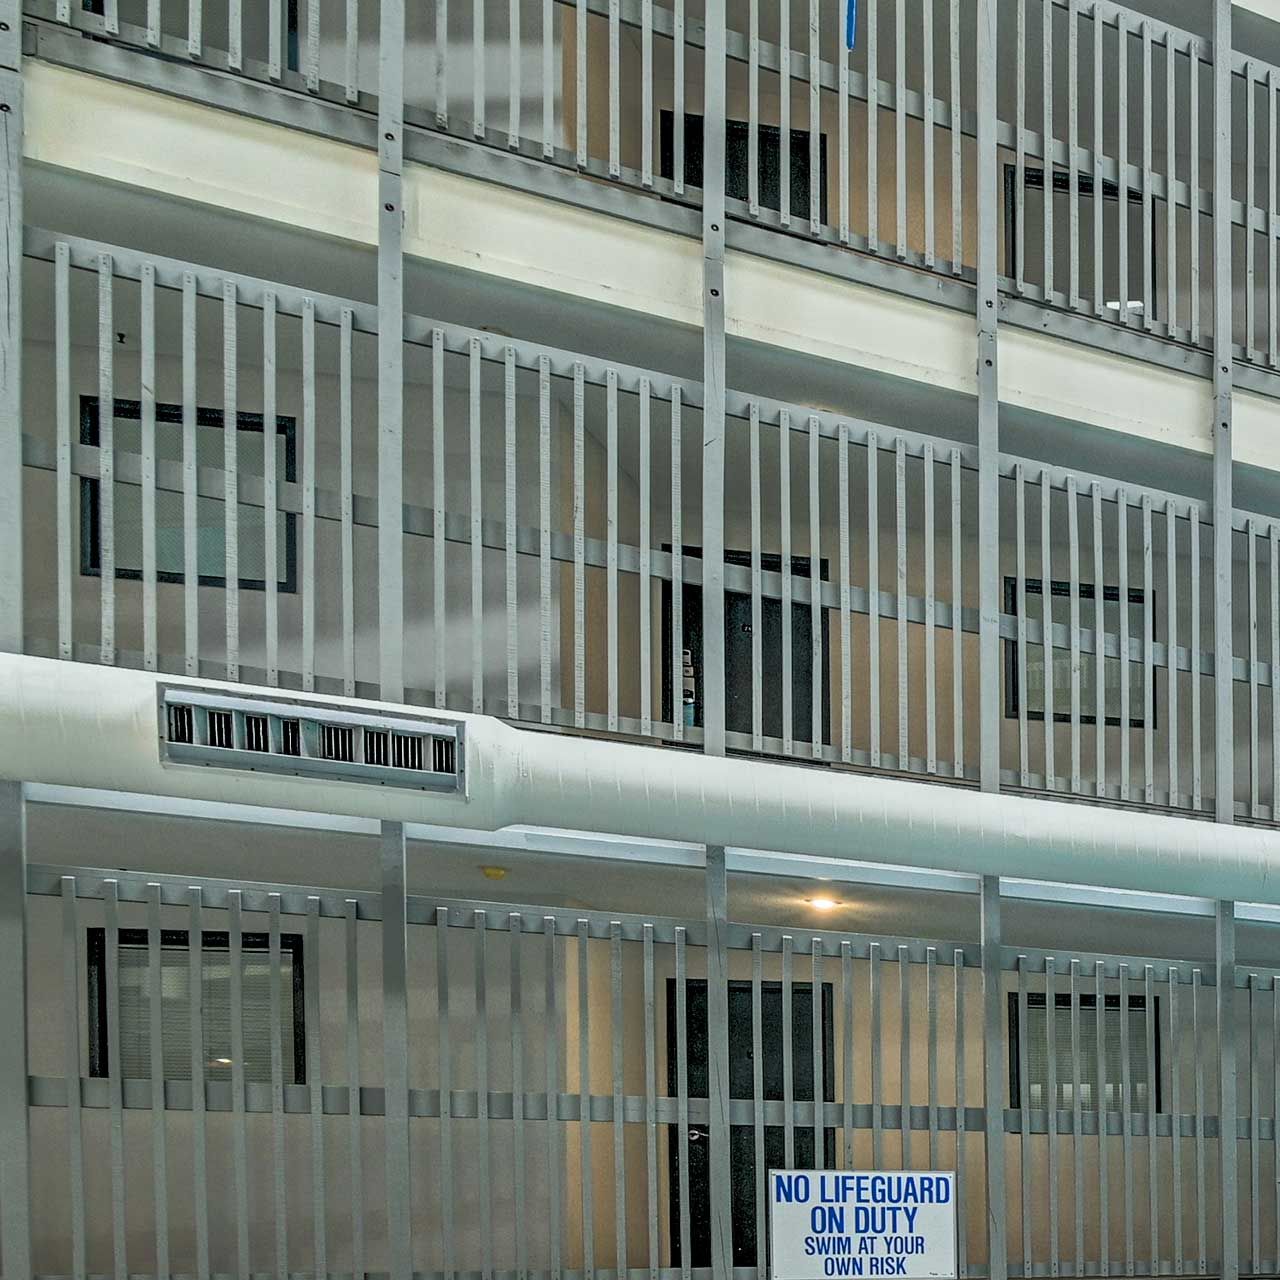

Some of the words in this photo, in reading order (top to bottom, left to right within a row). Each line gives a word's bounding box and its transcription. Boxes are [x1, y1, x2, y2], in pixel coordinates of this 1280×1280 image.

[776, 1175, 809, 1203] NO
[820, 1175, 950, 1204] LIFEGUARD
[810, 1206, 844, 1234] ON
[855, 1207, 917, 1234] DUTY
[804, 1236, 851, 1255] SWIM
[858, 1236, 877, 1255] AT
[884, 1236, 925, 1255] YOUR
[824, 1257, 862, 1276] OWN
[869, 1257, 906, 1275] RISK
